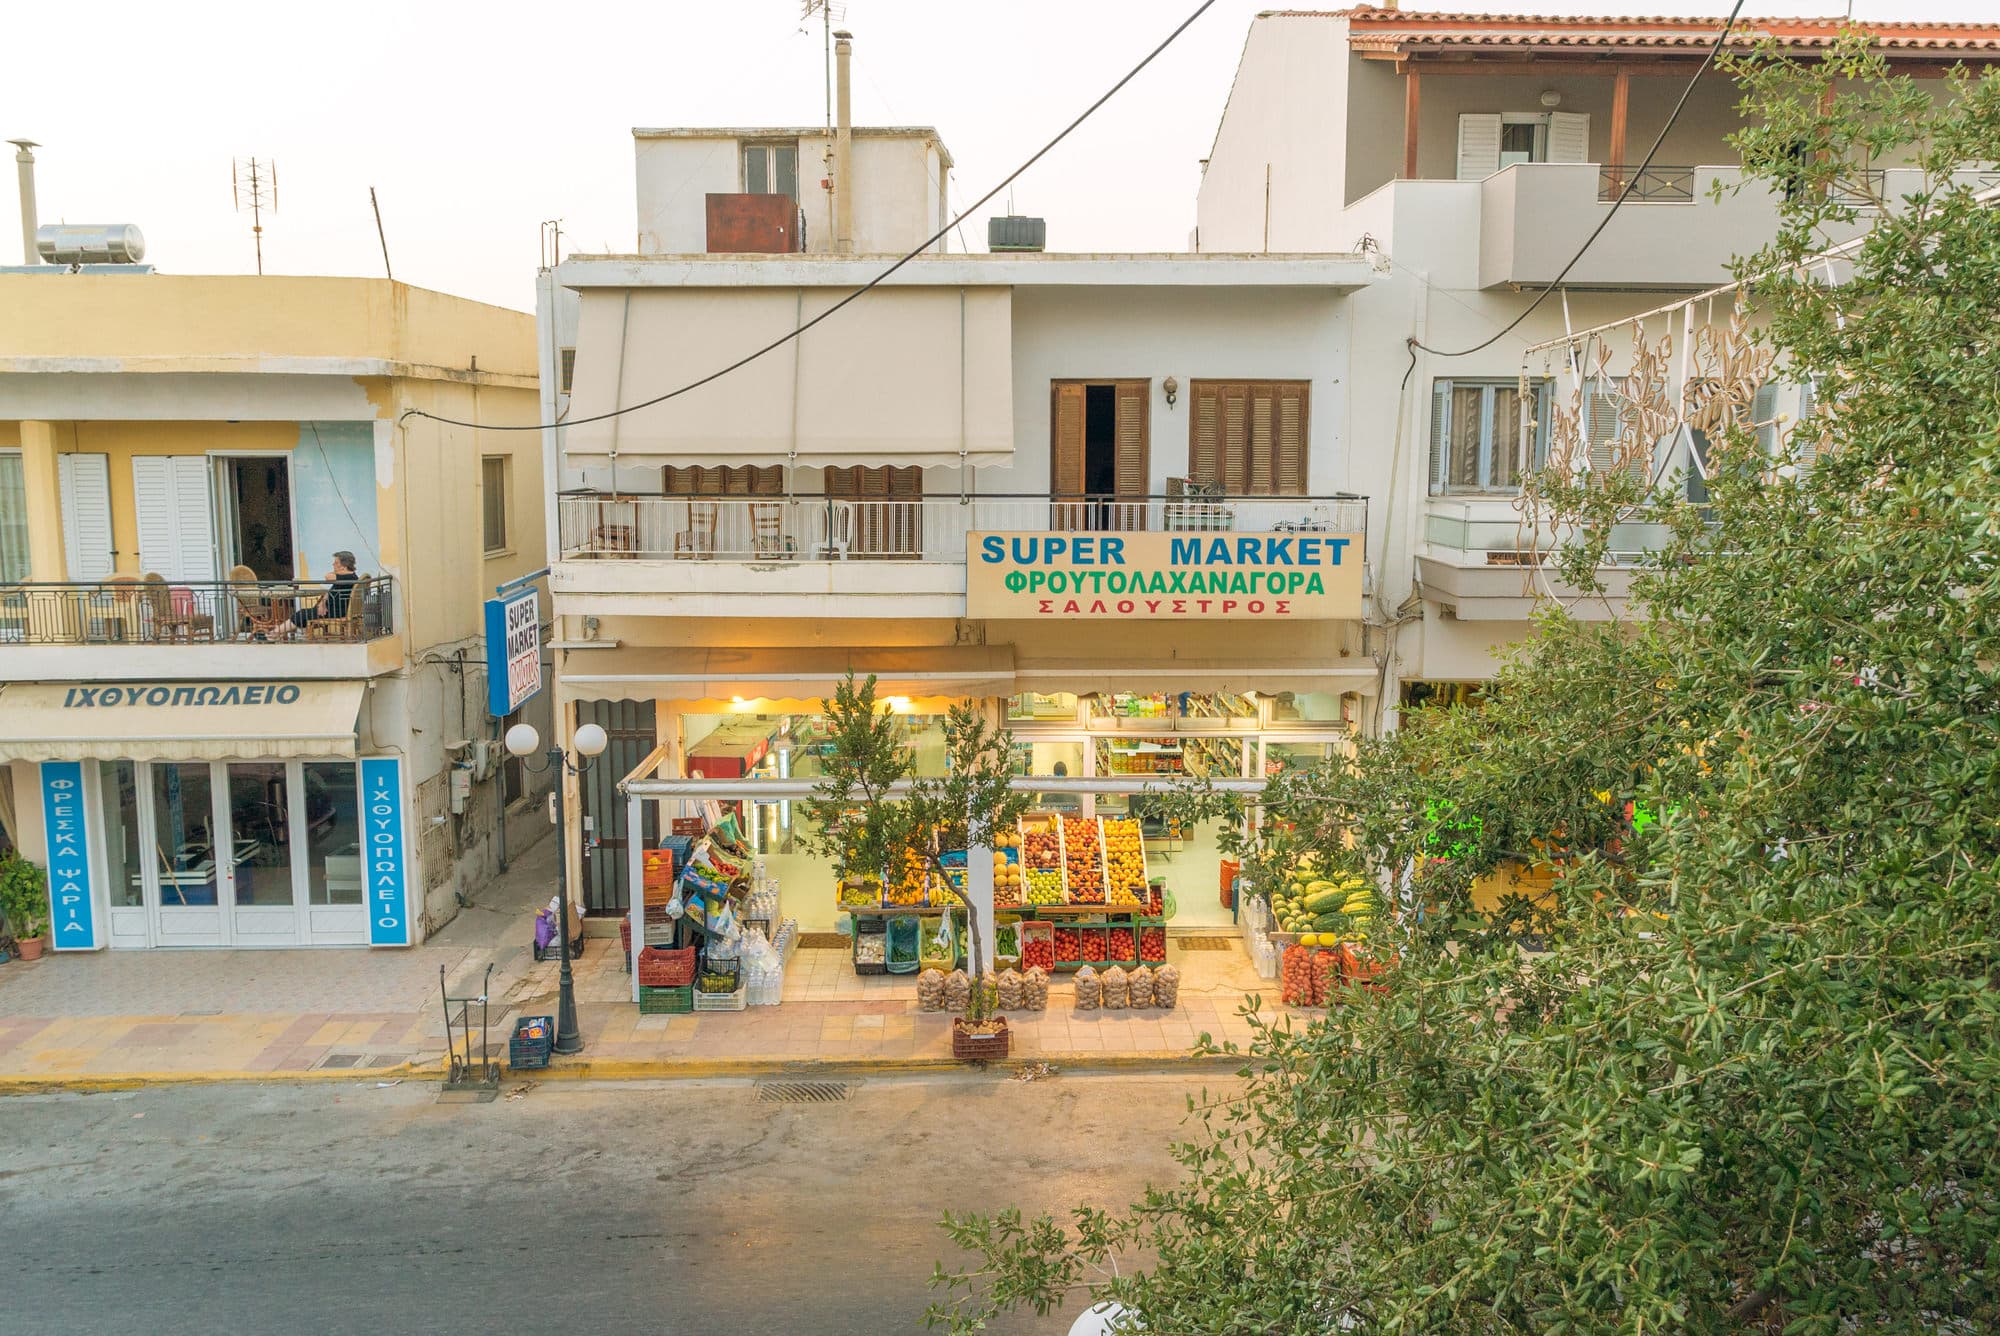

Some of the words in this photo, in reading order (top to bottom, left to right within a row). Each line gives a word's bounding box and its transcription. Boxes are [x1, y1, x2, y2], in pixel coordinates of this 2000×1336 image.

[981, 536, 1126, 565] SUPER
[1170, 538, 1351, 567] MARKET
[1004, 570, 1326, 596] ΦΡΟΥΤΟΛΑΧΑΝΑΓΟΡΑ
[509, 598, 535, 631] SUPER
[1038, 600, 1291, 614] ΣΑΛΟΥΣΤΡΟΣ
[508, 623, 538, 660] MARKET
[63, 685, 300, 708] ΙΧΘΥΟΠΩΛΕΙΟ
[50, 779, 79, 857] ΦΡΕΣΚΑ
[372, 776, 399, 928] ΙΧΘΥΟΠΩΛΕΙΟ
[57, 868, 85, 932] ΨΑΡΙΑ
